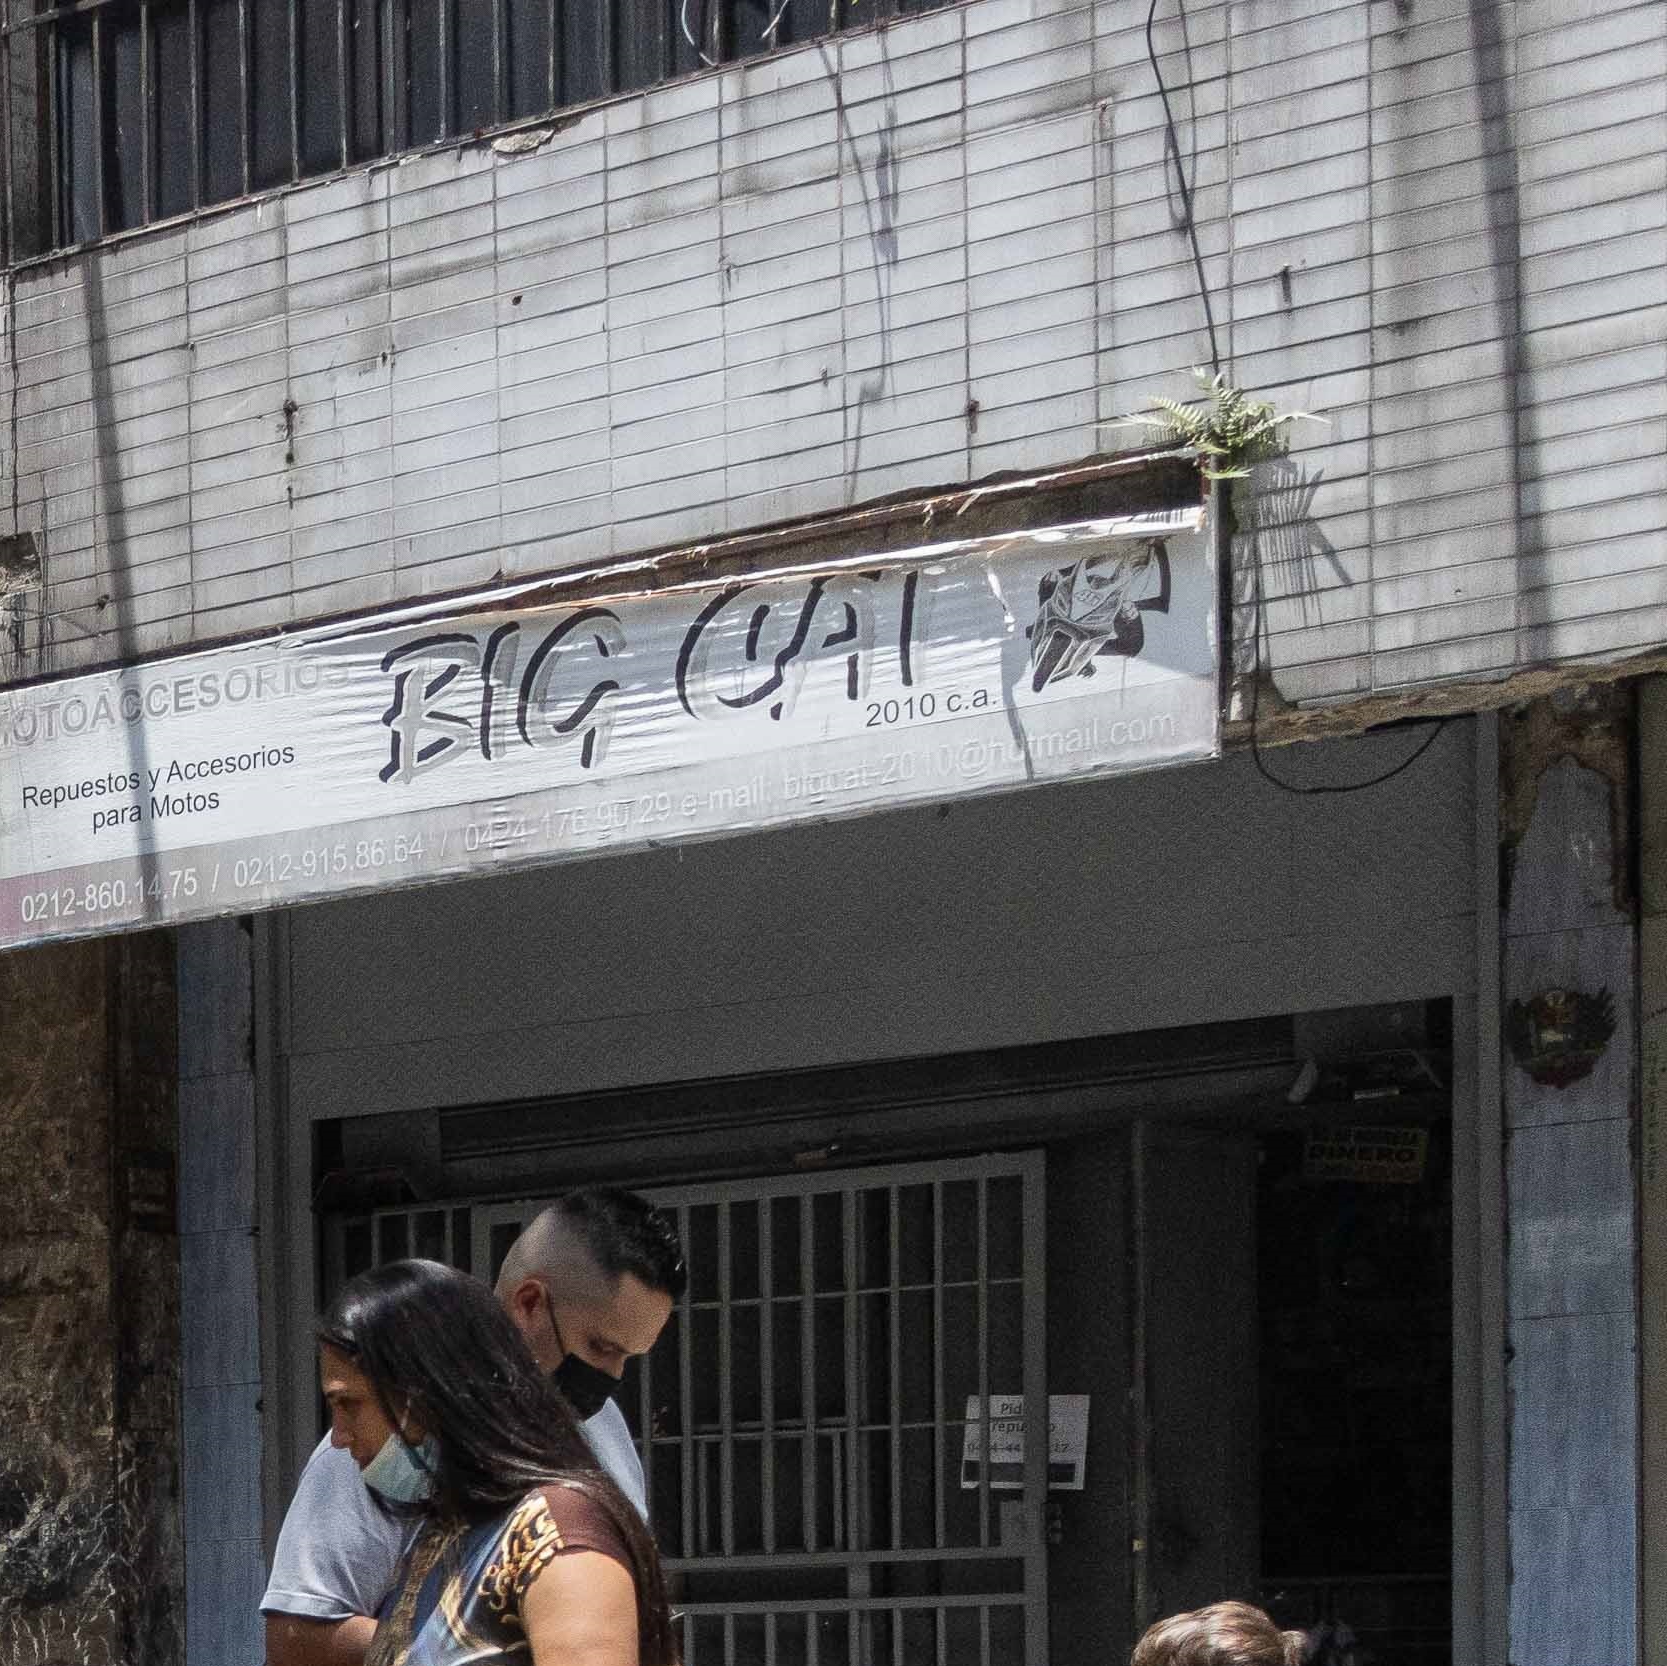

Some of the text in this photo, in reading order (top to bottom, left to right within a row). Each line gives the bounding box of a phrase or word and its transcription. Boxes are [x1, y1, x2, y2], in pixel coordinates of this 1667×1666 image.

[378, 607, 624, 784] BIG
[865, 687, 997, 728] 2010 c.a.
[21, 743, 296, 810] Repuestos y Accesorios
[92, 787, 221, 834] para Motos
[20, 869, 199, 923] 0212-860.14.75
[234, 834, 422, 889] 0212-915.86.64
